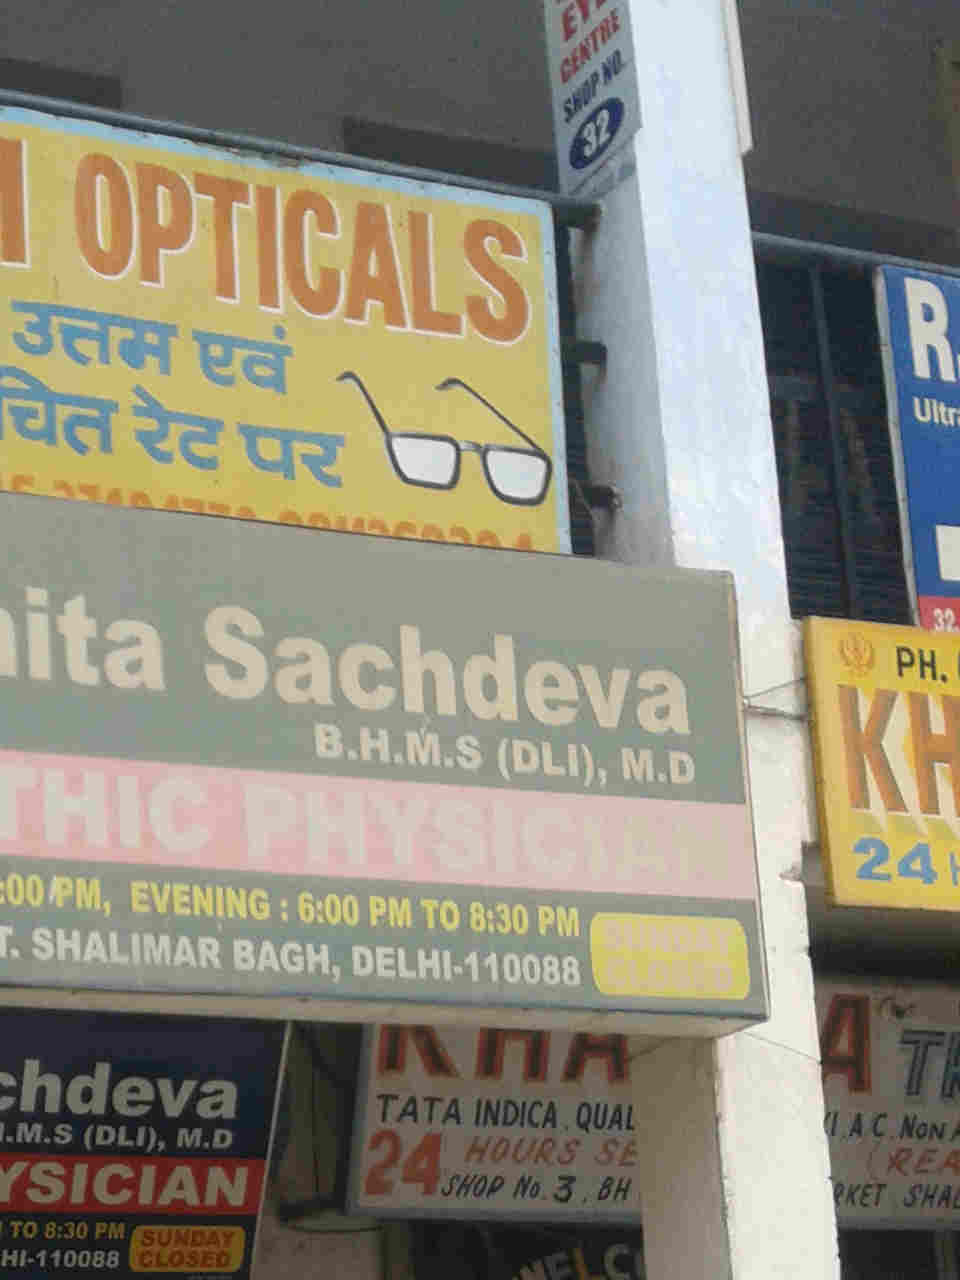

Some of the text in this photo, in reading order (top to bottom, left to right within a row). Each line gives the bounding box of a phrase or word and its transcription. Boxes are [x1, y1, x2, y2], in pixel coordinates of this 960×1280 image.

[581, 107, 611, 157] 32
[73, 151, 531, 346] OPTICALS
[10, 300, 179, 377] उत्तम
[191, 323, 294, 396] एवं
[131, 383, 225, 471] रेट
[236, 421, 346, 489] पर
[203, 605, 691, 735] Sachdeva
[313, 723, 696, 786] B.H.M.S (DLI), M.D
[241, 779, 736, 884] PHYSICIAN
[852, 836, 938, 886] 24
[298, 893, 359, 926] 6:00
[369, 896, 412, 928] PM
[421, 899, 460, 931] TO
[469, 902, 529, 935] 8:30
[538, 905, 580, 937] PM
[31, 927, 222, 970] SHALIMAR
[232, 940, 341, 982] BAGH,
[352, 946, 582, 987] DELHI-110088
[376, 1094, 463, 1126] TATA
[84, 1125, 166, 1153] (DLI),
[176, 1128, 233, 1150] M.D
[365, 1130, 442, 1195] 24
[464, 1136, 581, 1166] HOURS
[441, 1174, 505, 1199] SHOP
[10, 1222, 38, 1239] TO
[44, 1221, 88, 1240] 8:30
[95, 1222, 125, 1241] PM
[142, 1228, 235, 1248] SUNDAY
